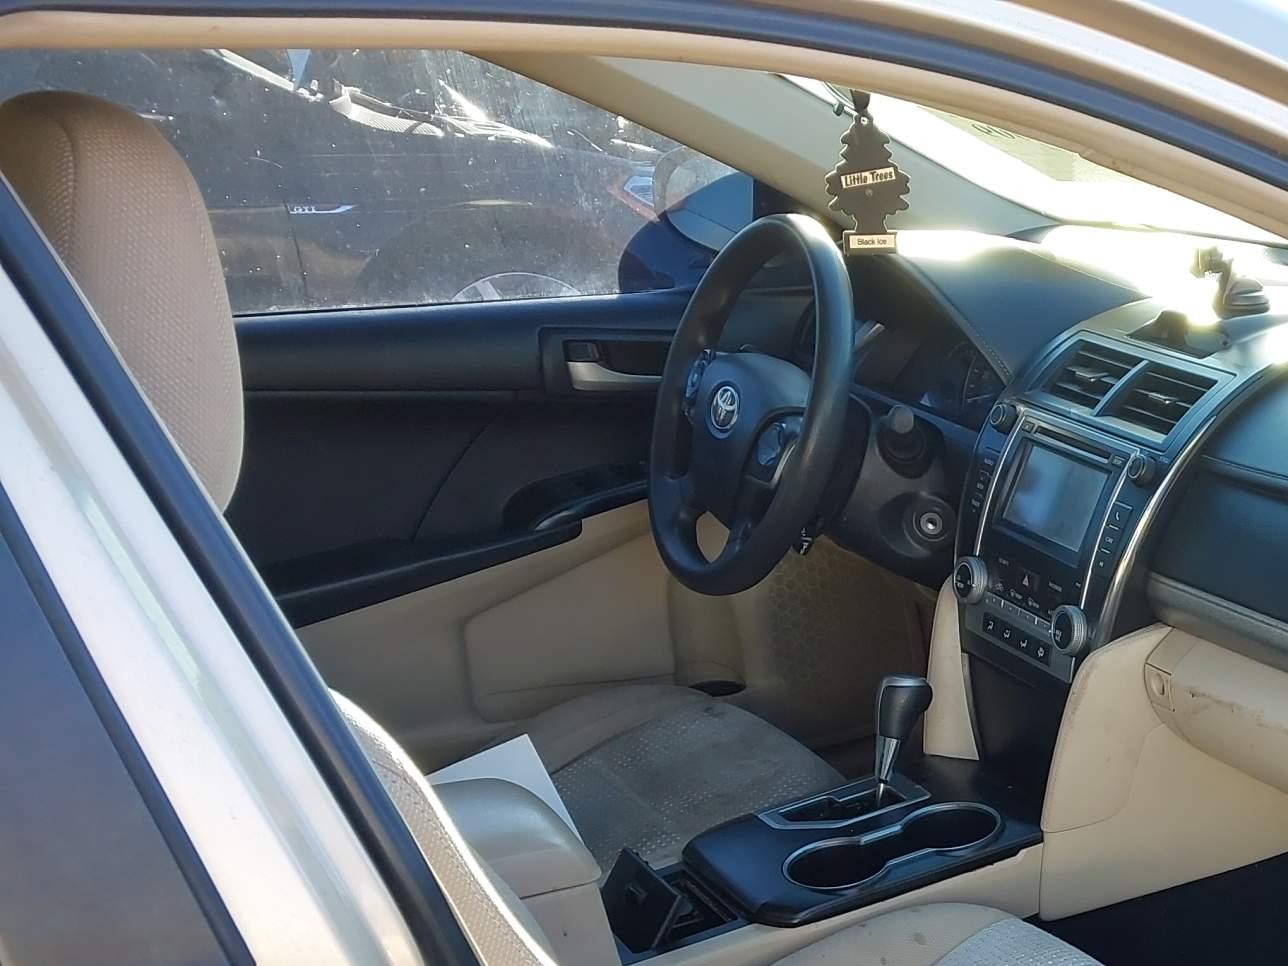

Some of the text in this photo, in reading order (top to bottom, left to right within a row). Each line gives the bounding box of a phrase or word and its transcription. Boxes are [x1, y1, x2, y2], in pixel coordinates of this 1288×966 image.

[844, 170, 893, 187] Little Trees
[857, 238, 875, 246] Black
